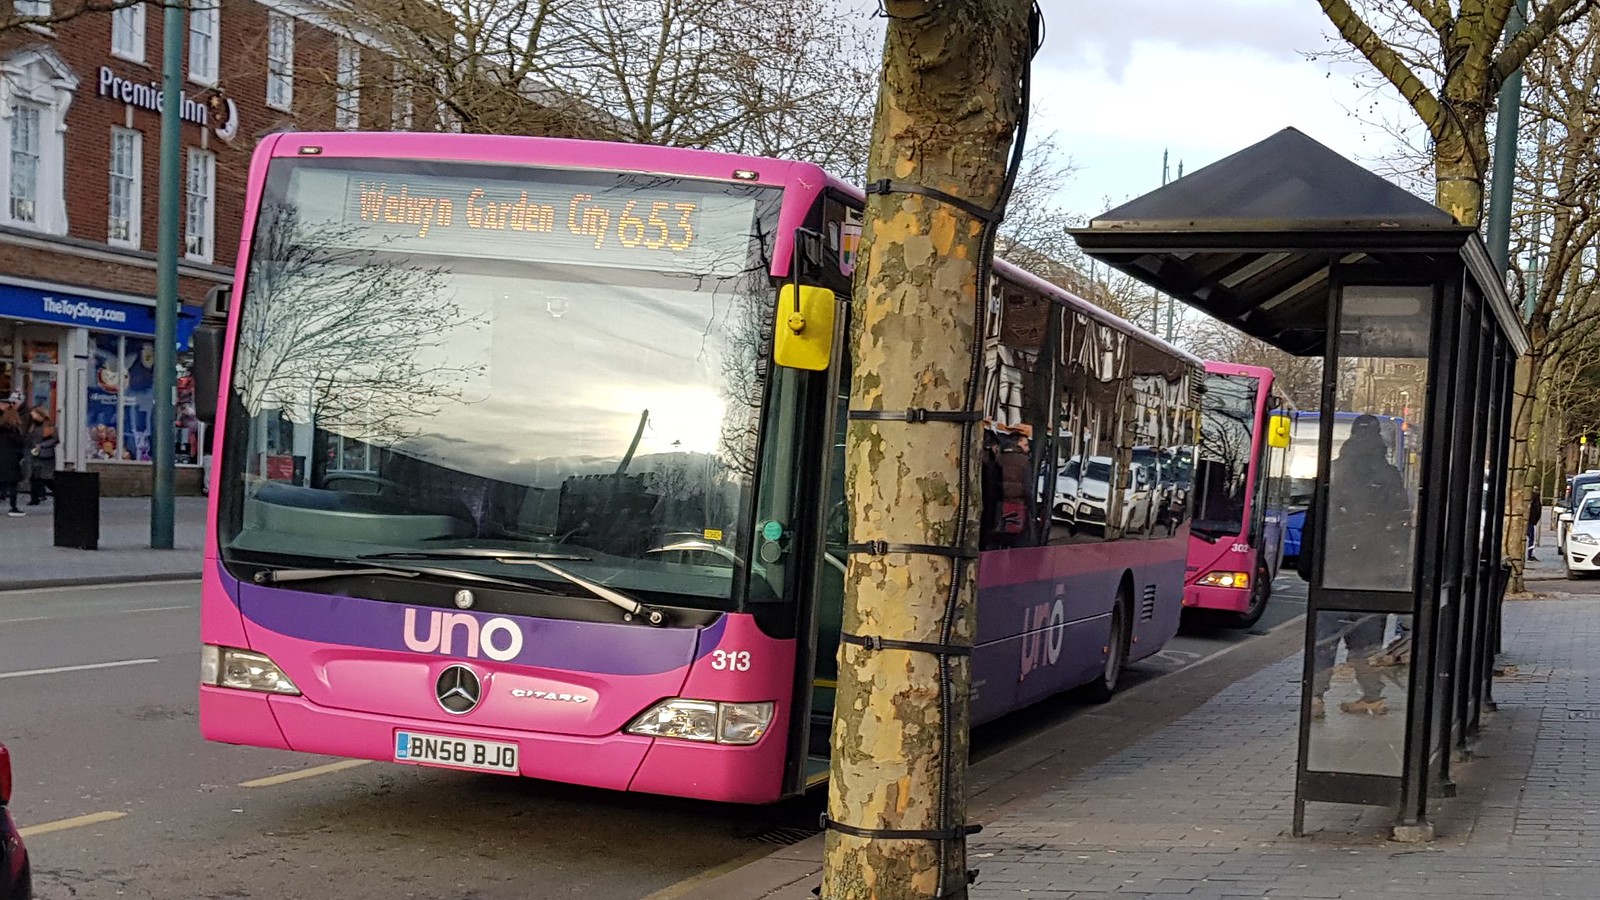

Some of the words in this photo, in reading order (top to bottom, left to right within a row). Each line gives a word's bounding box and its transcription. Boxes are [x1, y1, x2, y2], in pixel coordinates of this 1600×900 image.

[99, 65, 165, 113] Premie
[179, 91, 208, 125] Inn
[359, 181, 453, 238] Welwyn
[466, 187, 555, 233] Garden
[617, 200, 696, 252] 653
[42, 297, 126, 323] TheToyShop.com
[1231, 543, 1249, 553] 302
[403, 608, 523, 661] uno
[711, 649, 751, 672] 313
[511, 688, 588, 703] CITARO
[410, 736, 466, 763] BN58
